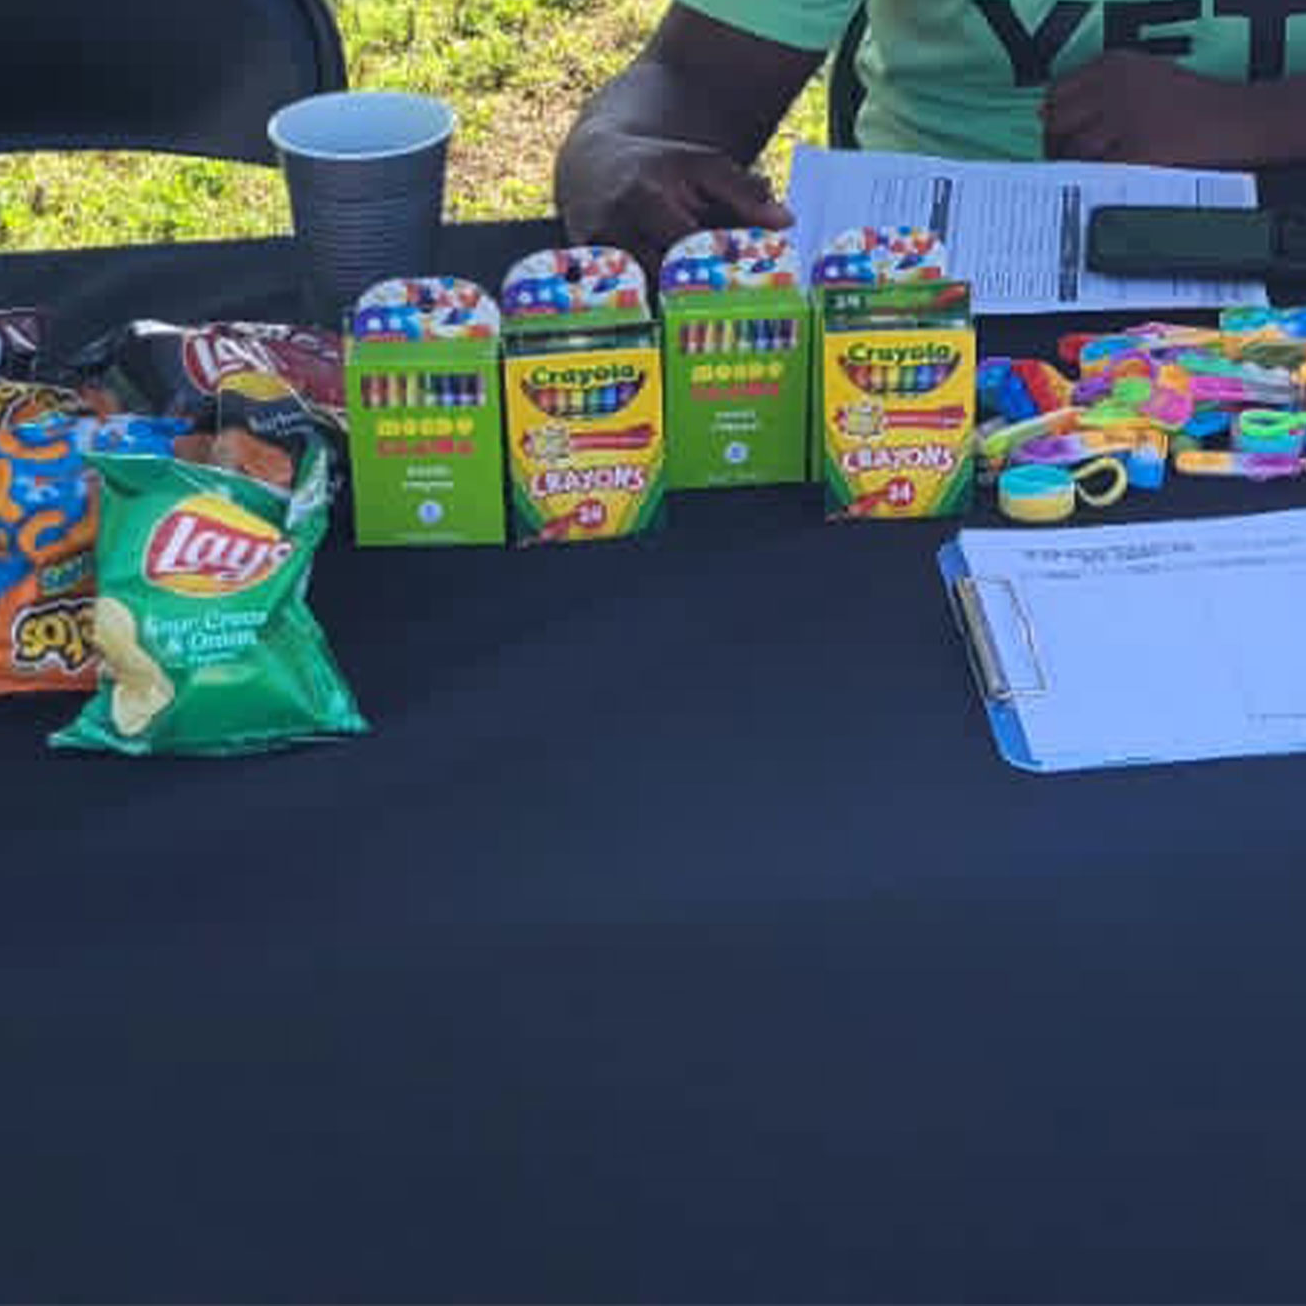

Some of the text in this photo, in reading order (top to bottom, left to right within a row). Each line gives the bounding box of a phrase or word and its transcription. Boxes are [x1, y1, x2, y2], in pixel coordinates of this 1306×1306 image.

[847, 342, 953, 366] Crayola
[531, 364, 636, 386] Crayola
[842, 446, 955, 472] CRAYONS
[531, 468, 644, 498] CRAYONS
